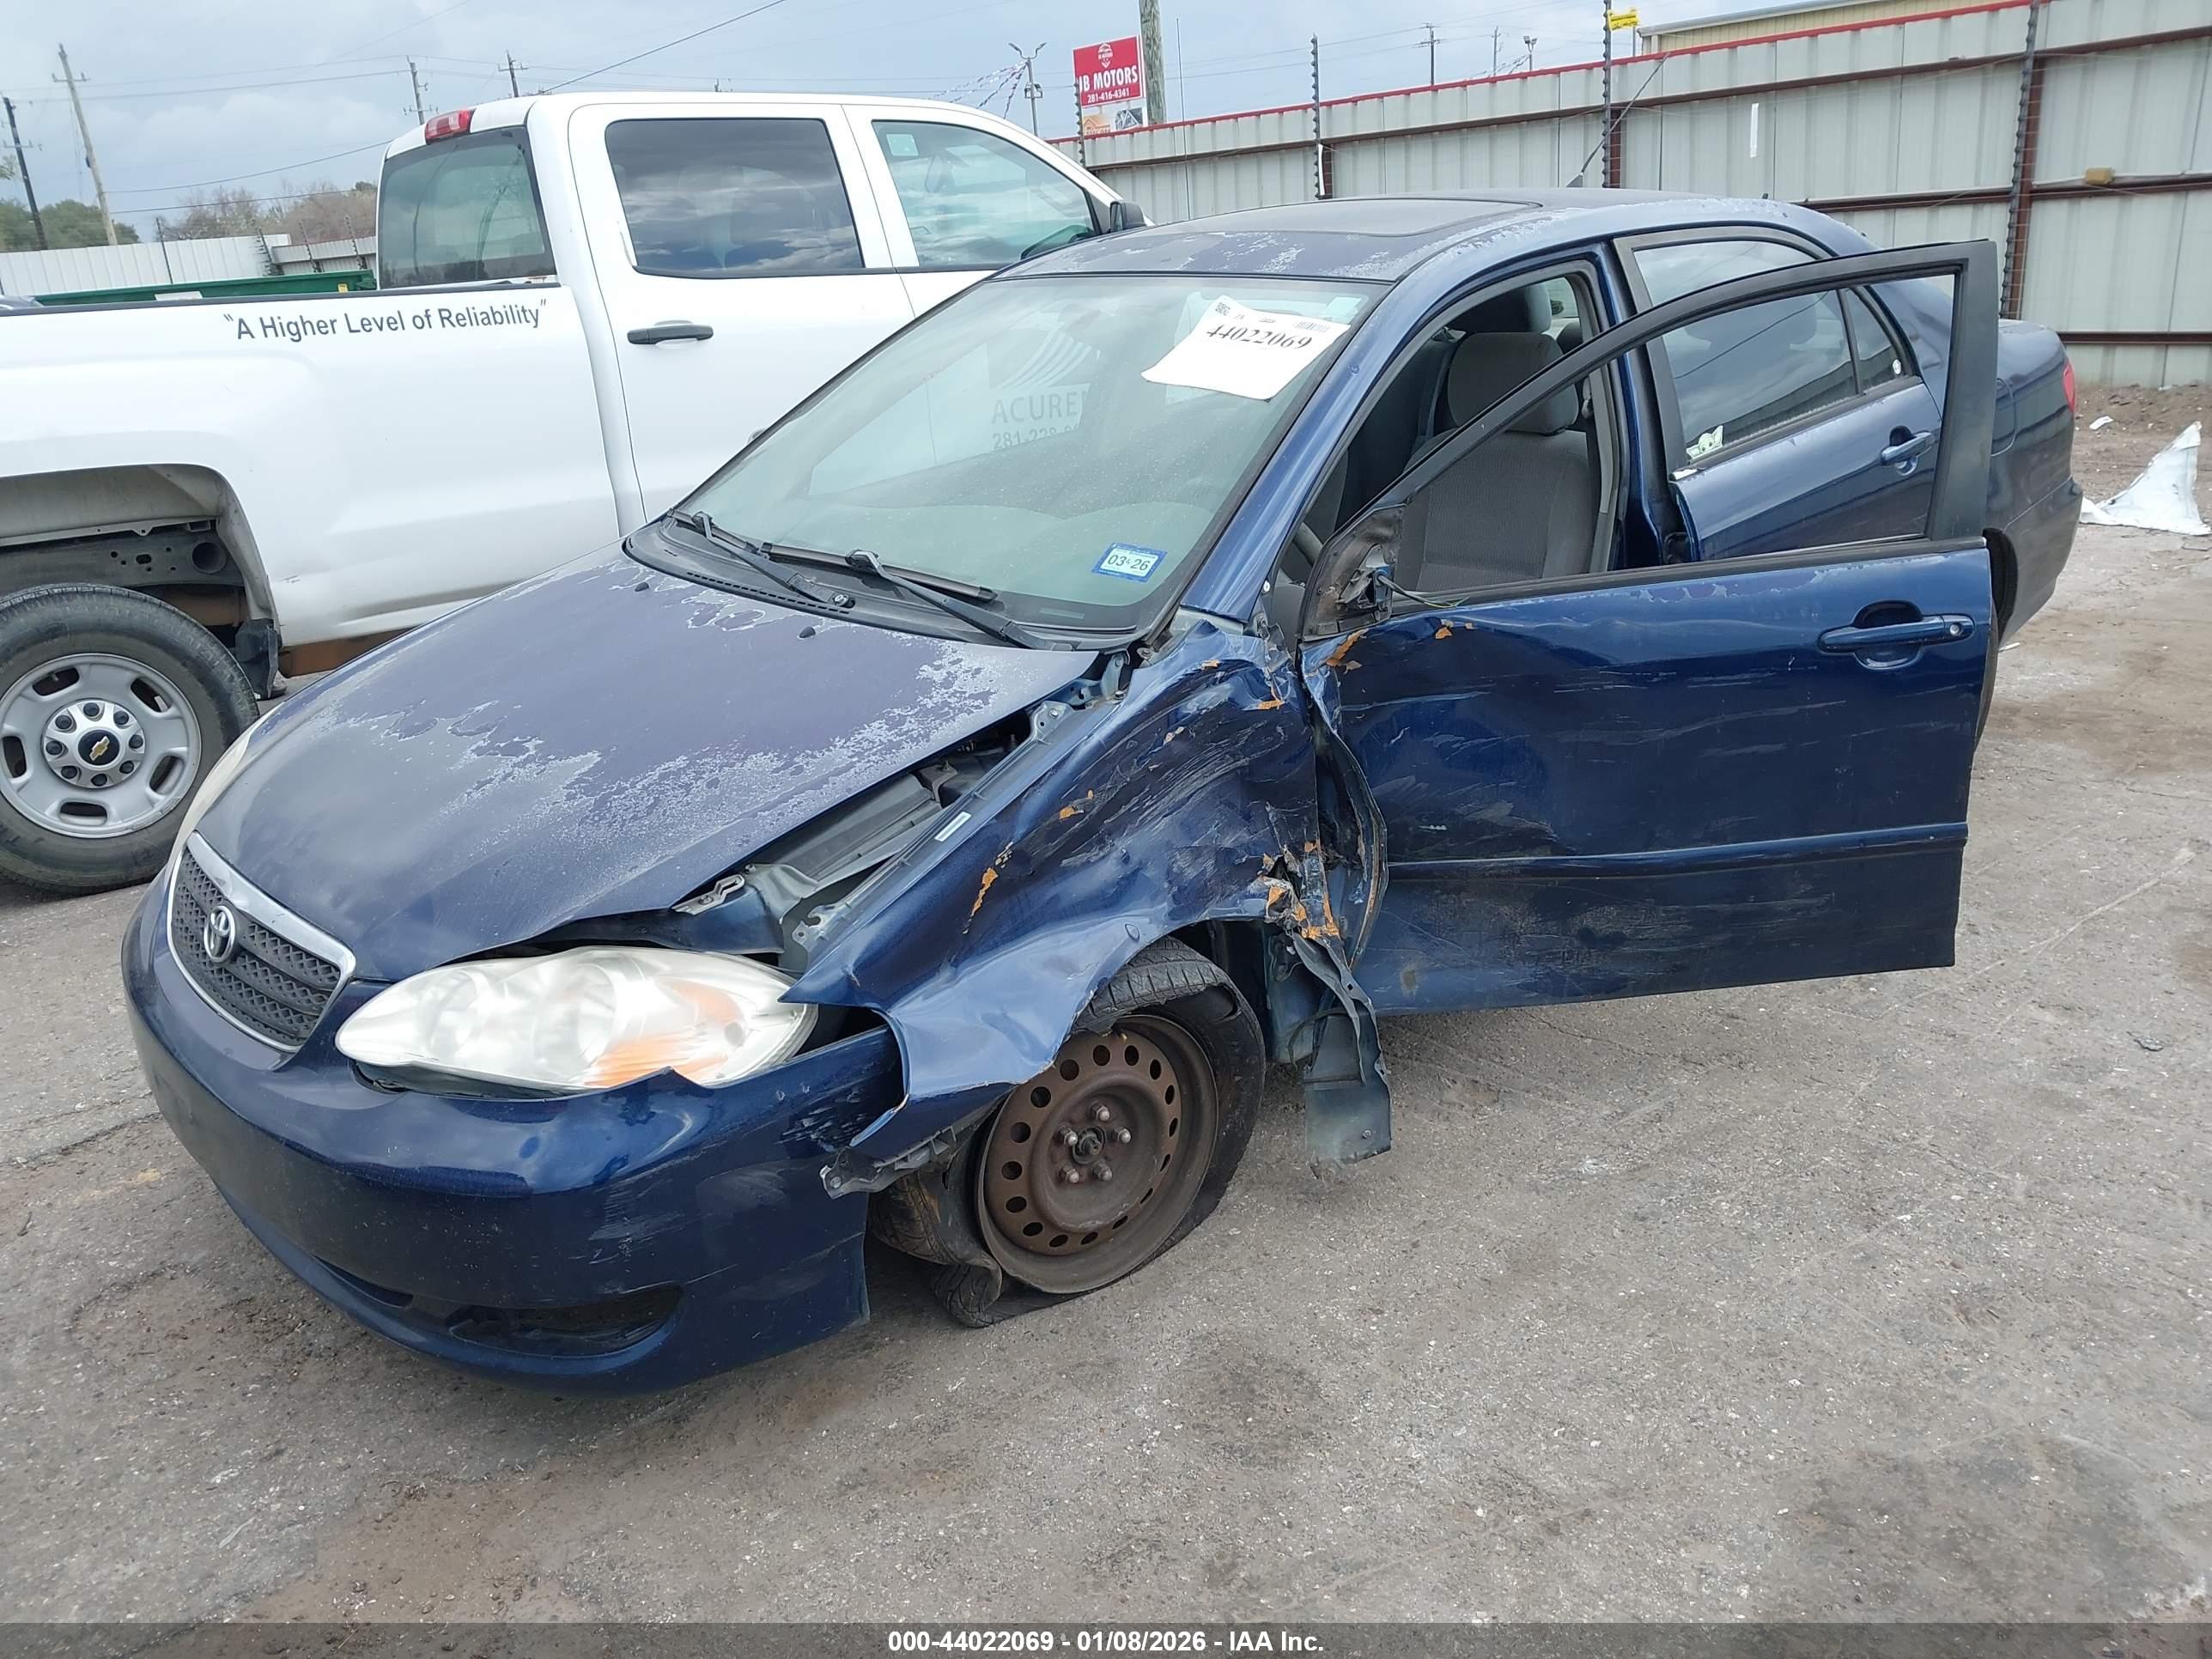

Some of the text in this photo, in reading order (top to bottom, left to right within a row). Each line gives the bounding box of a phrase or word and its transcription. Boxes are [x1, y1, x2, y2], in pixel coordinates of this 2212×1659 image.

[1093, 65, 1139, 90] MOTORS
[1087, 88, 1130, 104] 281-416-4341
[259, 315, 337, 343] Higher
[343, 310, 405, 334] Level
[411, 308, 433, 331] of
[1206, 324, 1314, 350] 44022069
